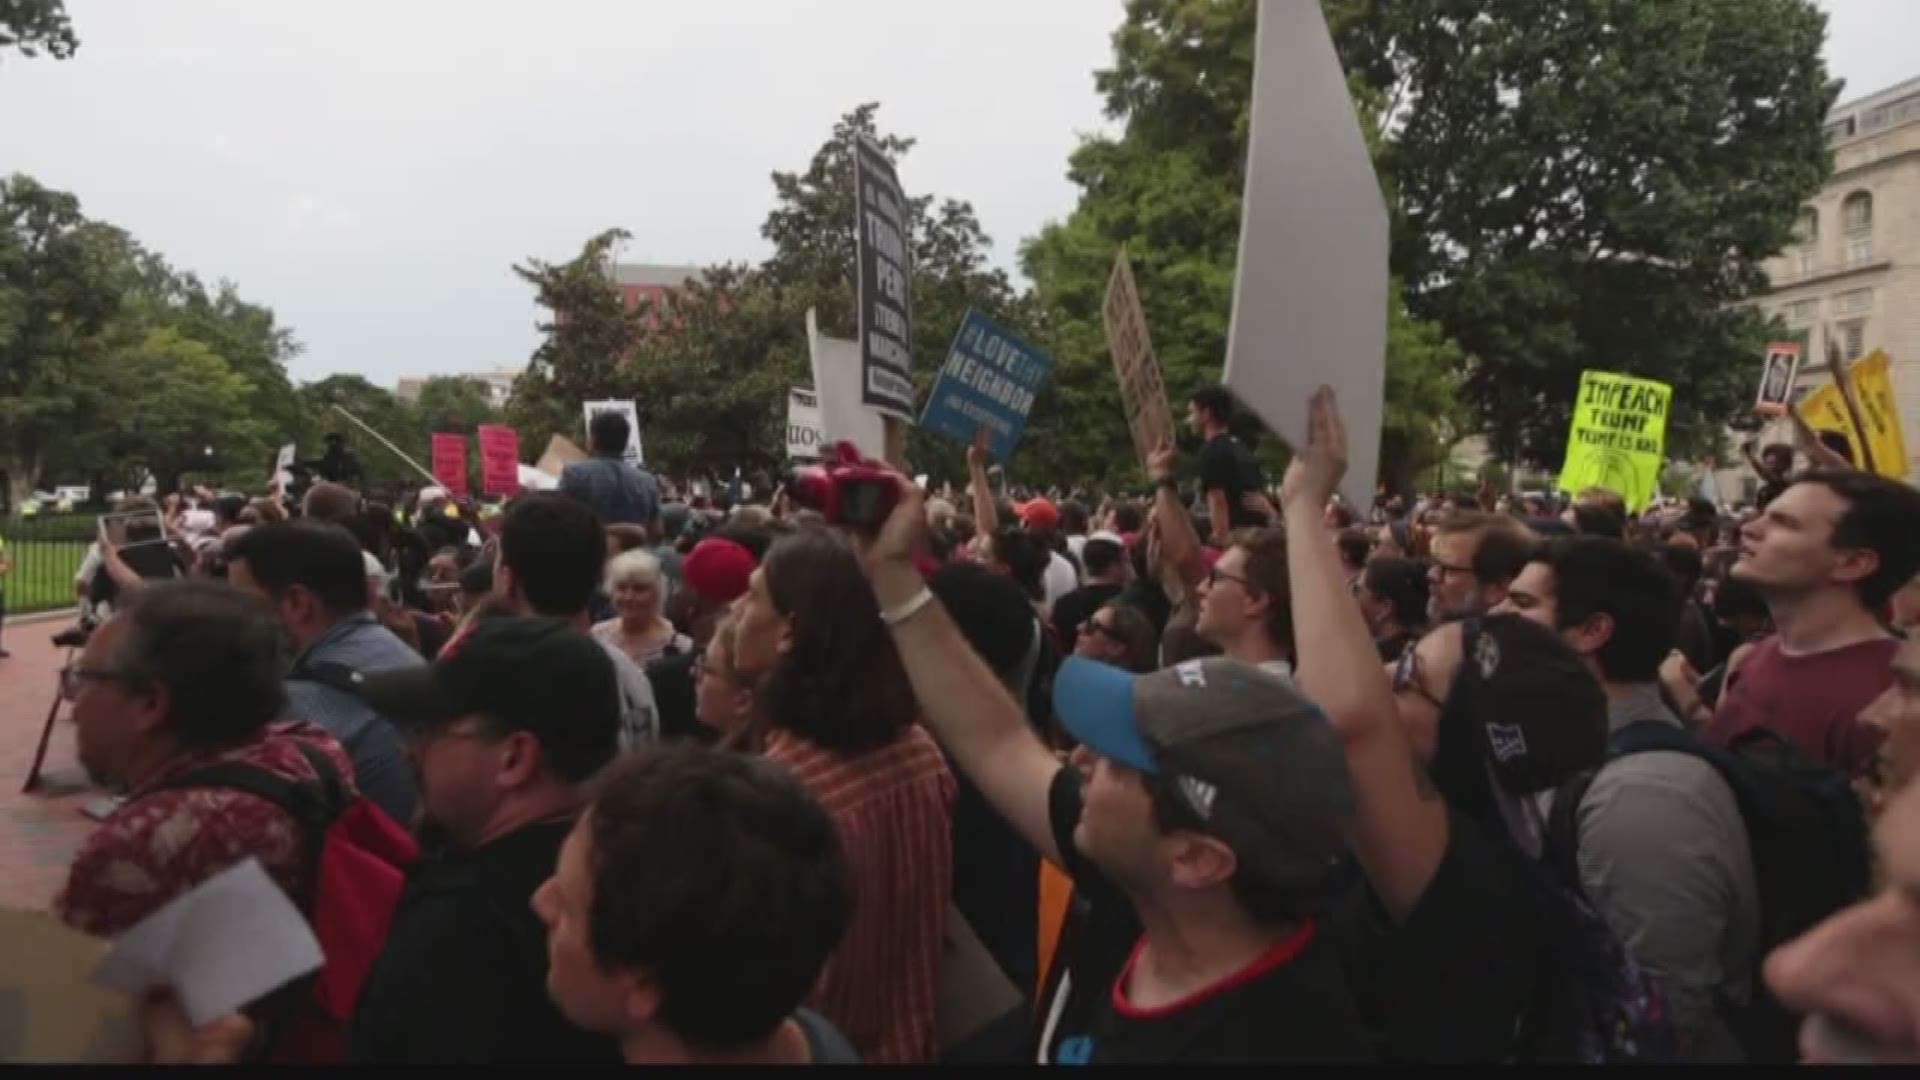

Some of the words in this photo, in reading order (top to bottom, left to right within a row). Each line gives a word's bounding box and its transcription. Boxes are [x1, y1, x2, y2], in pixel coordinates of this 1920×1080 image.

[945, 350, 1035, 416] NEIGHBOR
[1584, 380, 1664, 417] IMPEACH
[1591, 408, 1650, 433] TRUMP
